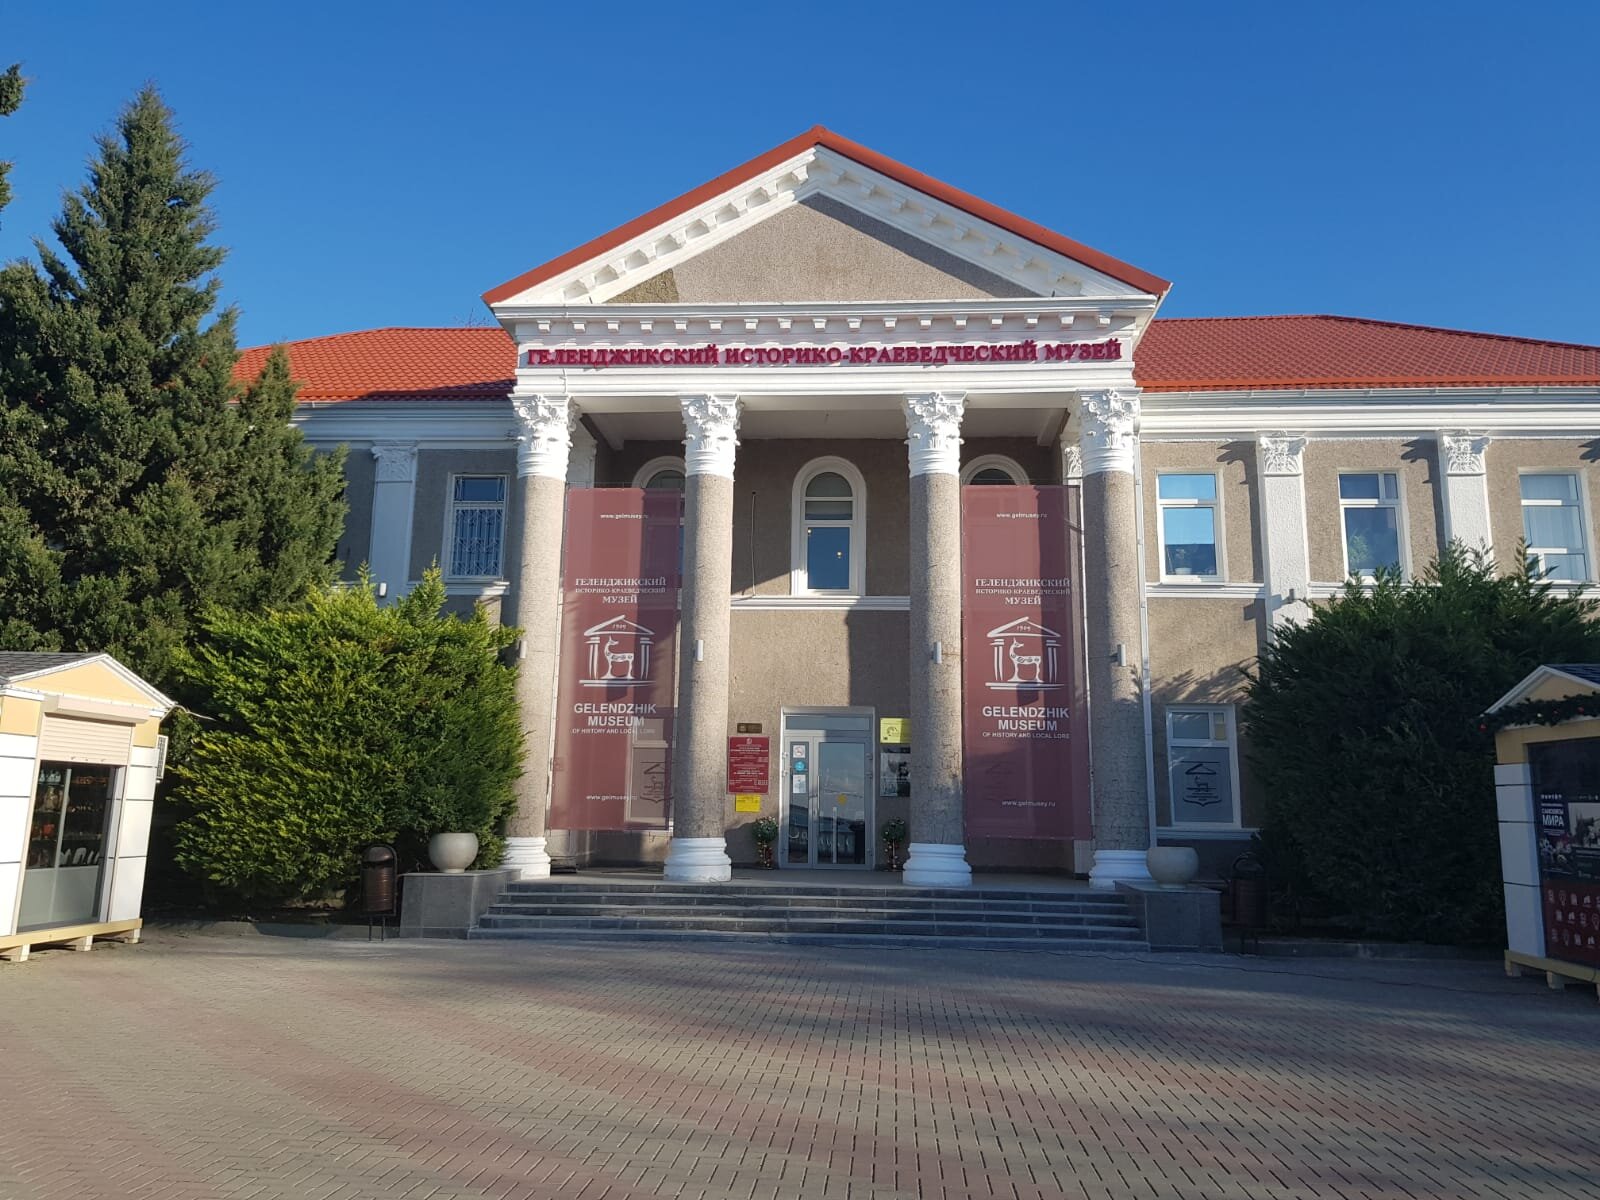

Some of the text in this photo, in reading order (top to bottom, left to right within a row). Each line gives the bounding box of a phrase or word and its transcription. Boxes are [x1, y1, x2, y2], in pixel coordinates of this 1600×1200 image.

[527, 338, 1122, 368] ГЕЛЕНДЖИКСКИЙ ИСТОРИКО-КРАЕВЕДЧЕСКИЙ МУЗЕЙ
[575, 577, 667, 587] ГЕЛЕНДЖИКСКИЙ
[975, 578, 1071, 588] ГЕЛЕНДЖИКСКИЙ
[602, 595, 638, 604] МУЗЕЙ
[1005, 596, 1042, 605] МУЗЕЙ
[574, 703, 657, 714] GELENDZHIK
[983, 706, 1069, 718] GELENDZHIK
[587, 716, 645, 727] MUSEUM
[998, 719, 1058, 731] MUSEUM
[1543, 815, 1564, 826] МИРА
